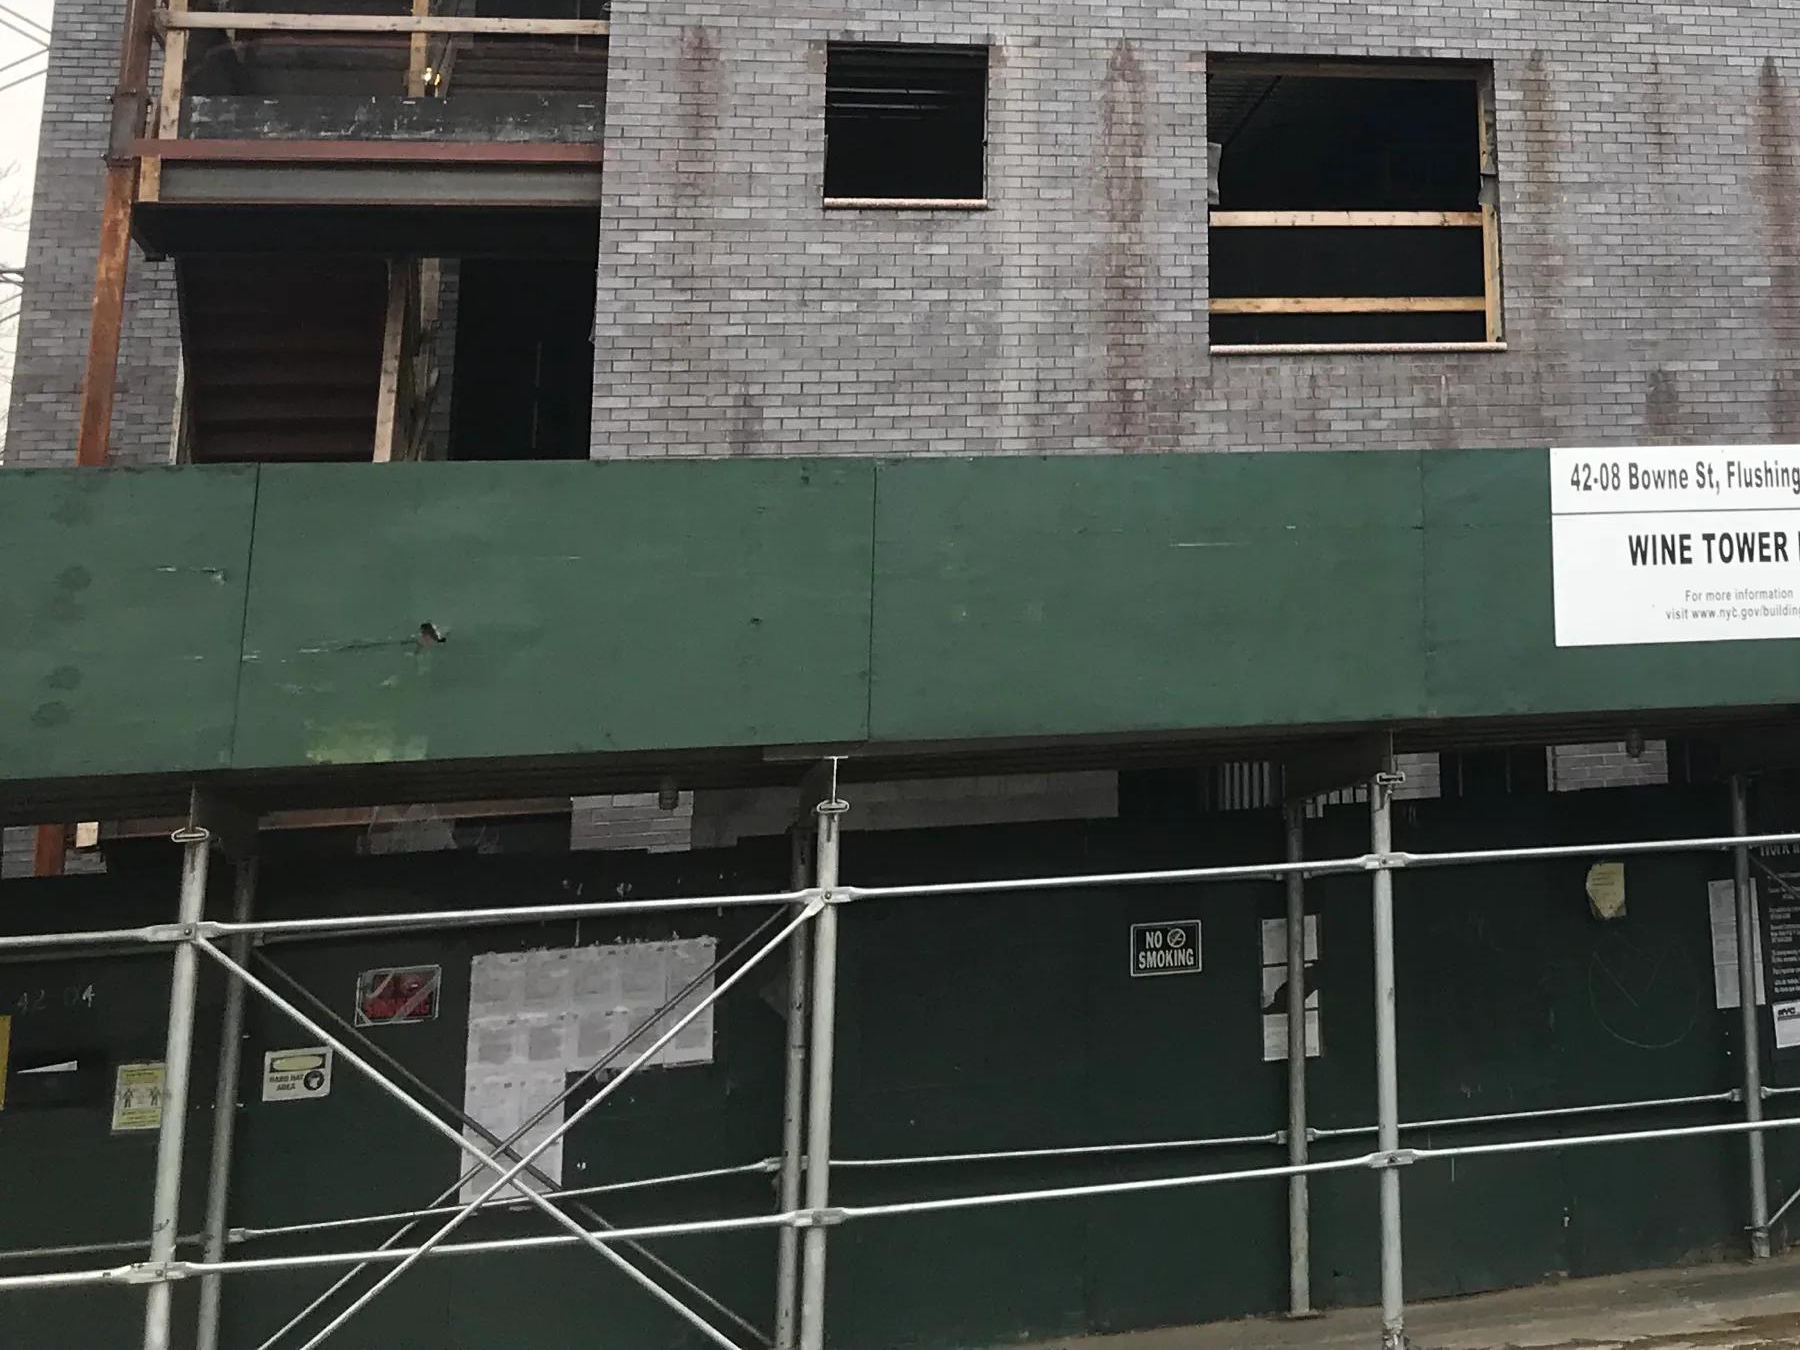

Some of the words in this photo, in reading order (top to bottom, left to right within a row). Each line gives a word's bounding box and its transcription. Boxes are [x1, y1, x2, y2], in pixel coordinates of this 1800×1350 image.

[1571, 462, 1621, 492] 42-08
[1628, 462, 1688, 490] Bowne
[1695, 461, 1720, 494] St,
[1727, 460, 1800, 495] Flushing
[1628, 534, 1692, 566] WINE
[1702, 532, 1789, 564] TOWER
[1685, 589, 1702, 602] For
[1706, 590, 1731, 601] more
[1735, 588, 1793, 600] information
[1665, 607, 1688, 620] visit
[1145, 930, 1163, 949] NO
[1138, 948, 1195, 969] SMOKING
